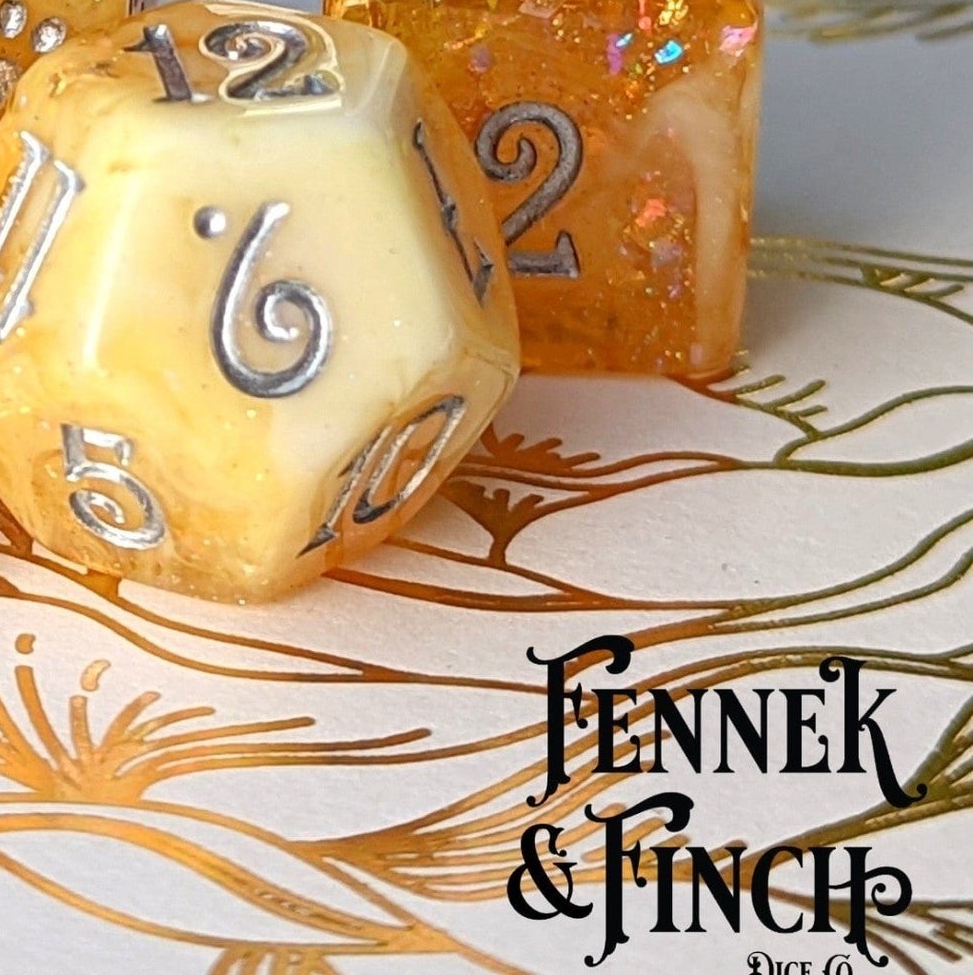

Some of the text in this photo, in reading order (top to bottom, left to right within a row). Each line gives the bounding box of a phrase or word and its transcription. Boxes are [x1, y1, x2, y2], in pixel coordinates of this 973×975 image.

[123, 22, 343, 103] 12
[474, 101, 583, 279] 2
[60, 423, 166, 551] 5
[296, 395, 467, 557] 10
